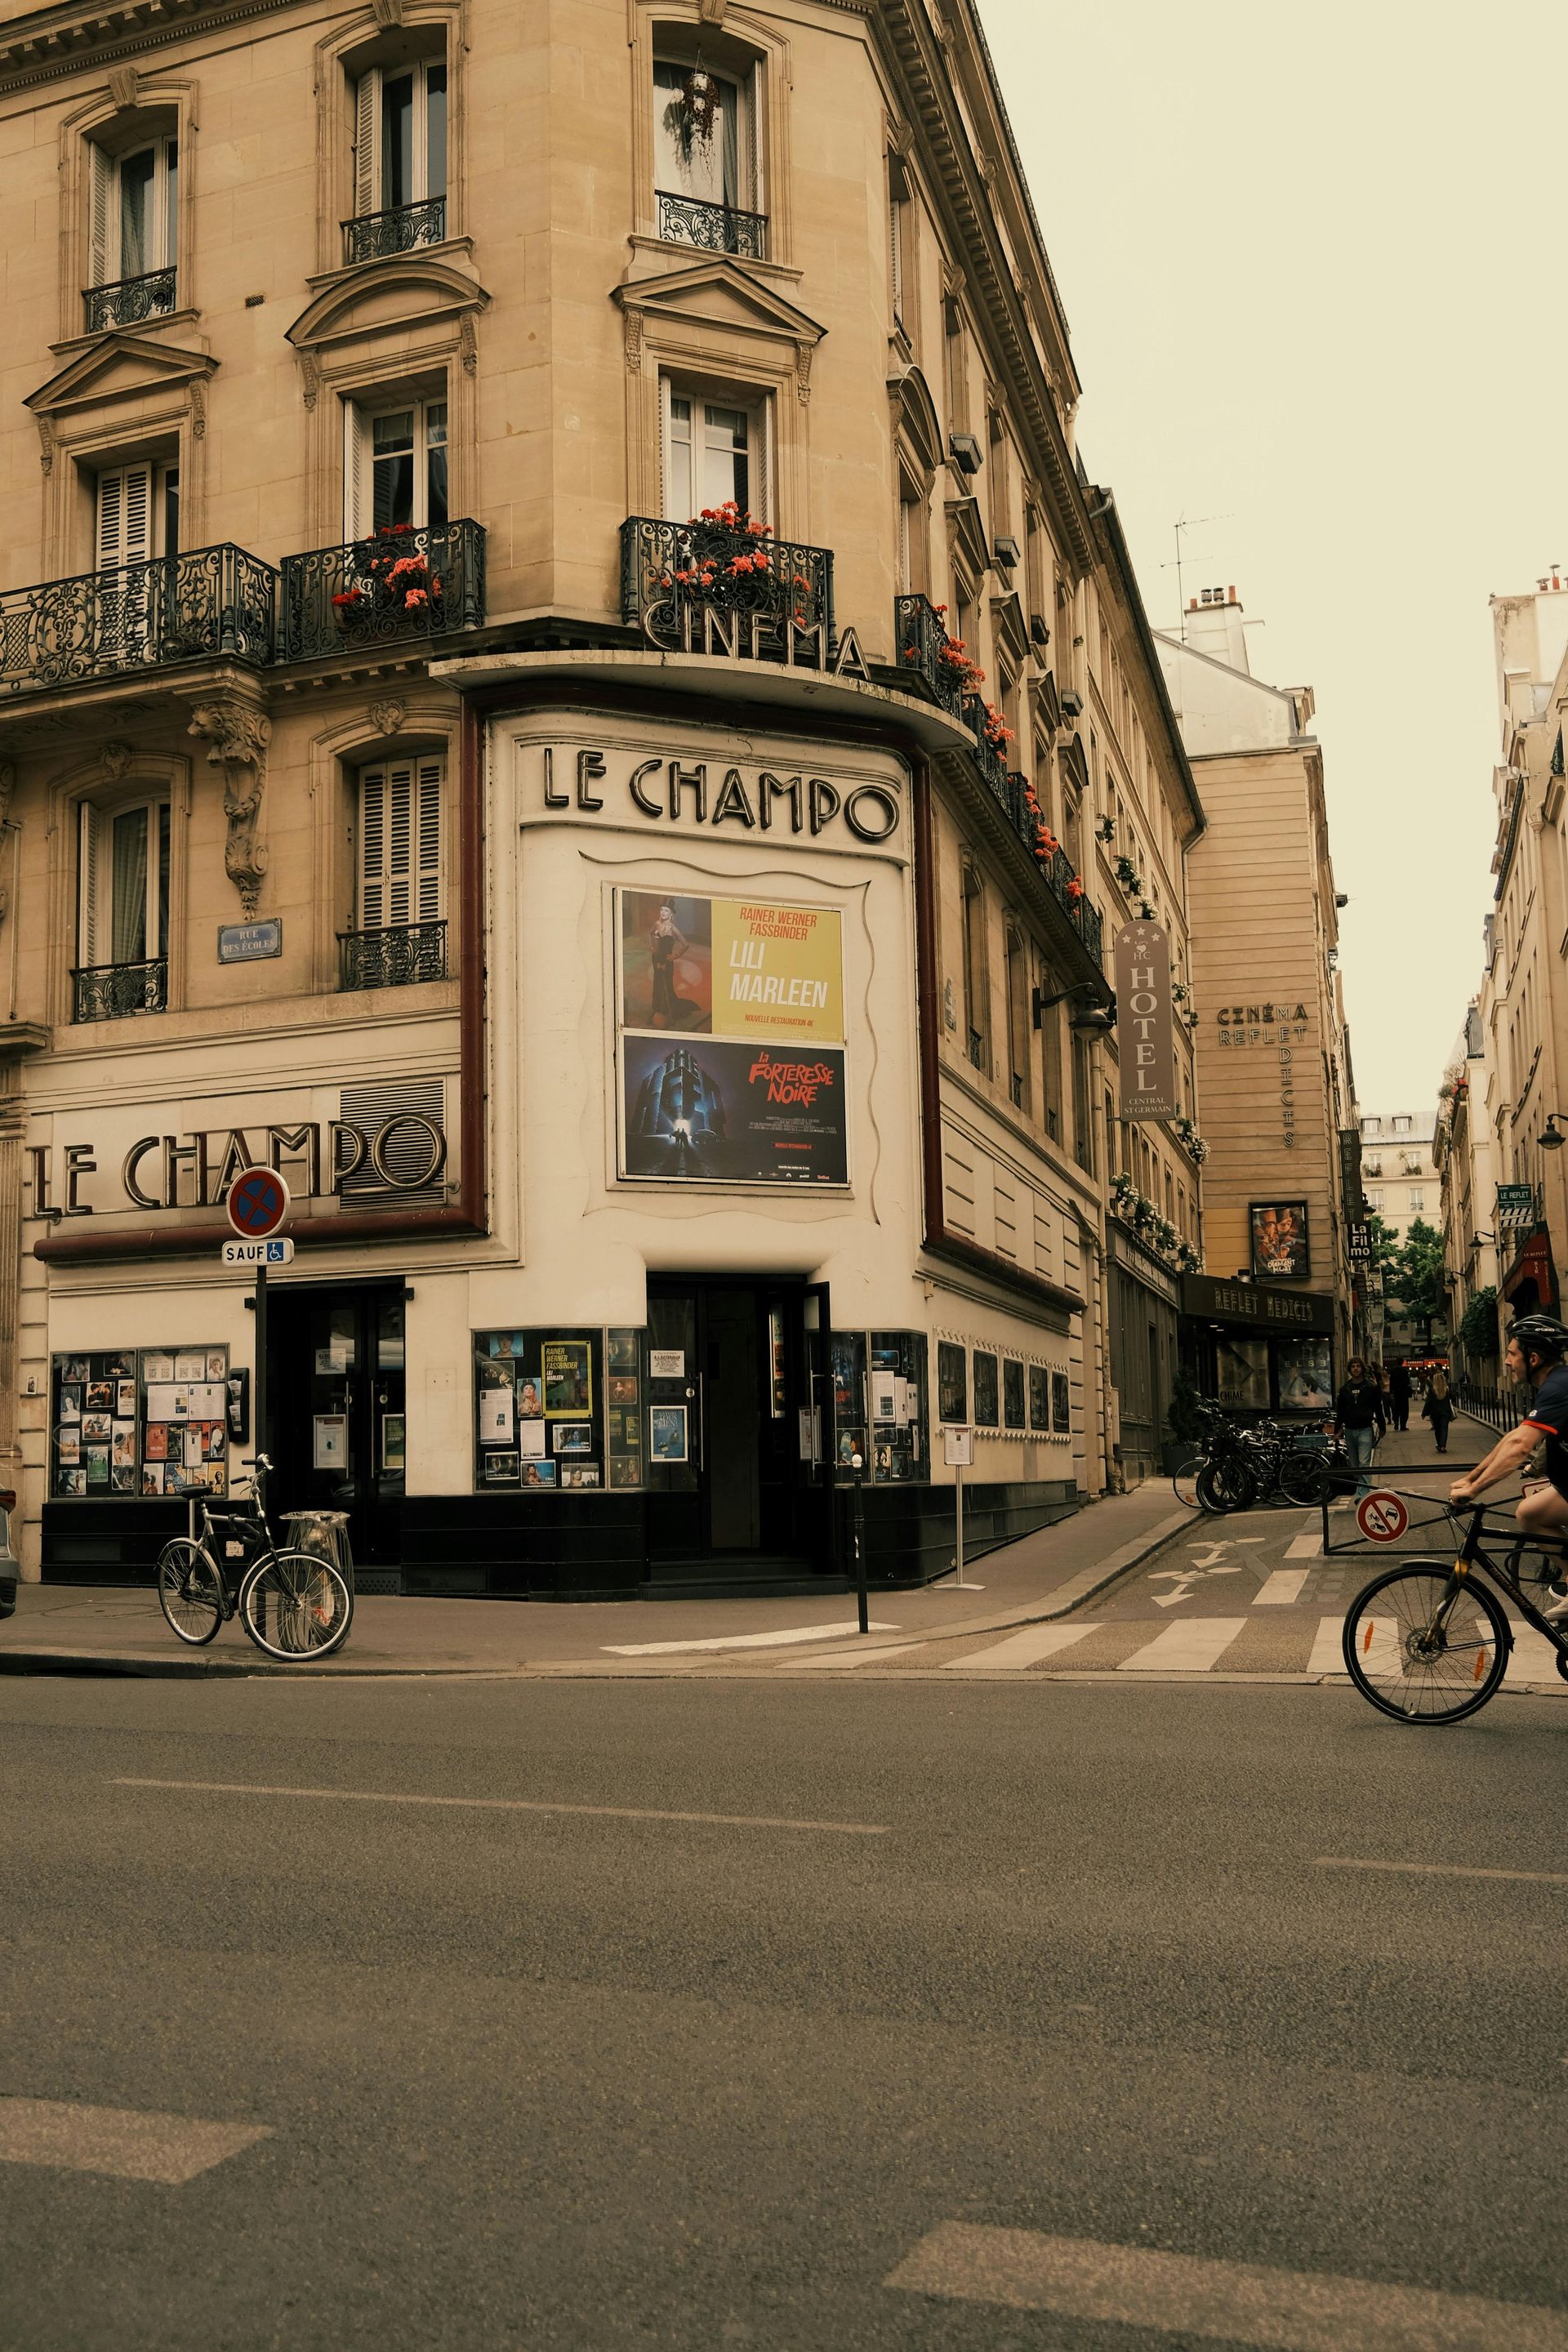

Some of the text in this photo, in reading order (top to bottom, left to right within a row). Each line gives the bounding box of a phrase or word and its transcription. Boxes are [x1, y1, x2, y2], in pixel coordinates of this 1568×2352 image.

[641, 599, 871, 681] CINEMA
[544, 747, 900, 841] LE CHAMPO
[739, 907, 817, 927] RAINER WERNER
[239, 929, 259, 941] RUE
[750, 924, 808, 941] FASSBINDER
[223, 943, 240, 954] DES
[729, 940, 765, 969] LILI
[729, 973, 828, 1009] MARLEEN
[745, 1014, 770, 1023] NOUVELLE
[770, 1016, 806, 1026] RESTAURATION
[1217, 1002, 1308, 1026] CINÉMA
[1129, 966, 1157, 1092] HOTEL
[1218, 1025, 1307, 1046] REFLET
[749, 1062, 834, 1085] FORTERESSE
[1125, 1105, 1172, 1114] ST GERMAIN
[1129, 1097, 1167, 1106] CENTRAL
[31, 1111, 448, 1218] LE CHAMPO
[1343, 1133, 1356, 1221] REFLET
[1509, 1191, 1529, 1199] REFLET
[1352, 1223, 1367, 1234] La
[1352, 1236, 1368, 1246] Fil
[225, 1245, 265, 1263] SAUF
[1351, 1247, 1370, 1257] mo
[1214, 1287, 1313, 1322] REFLET MEDICIS
[546, 1361, 577, 1370] FASSBINDER
